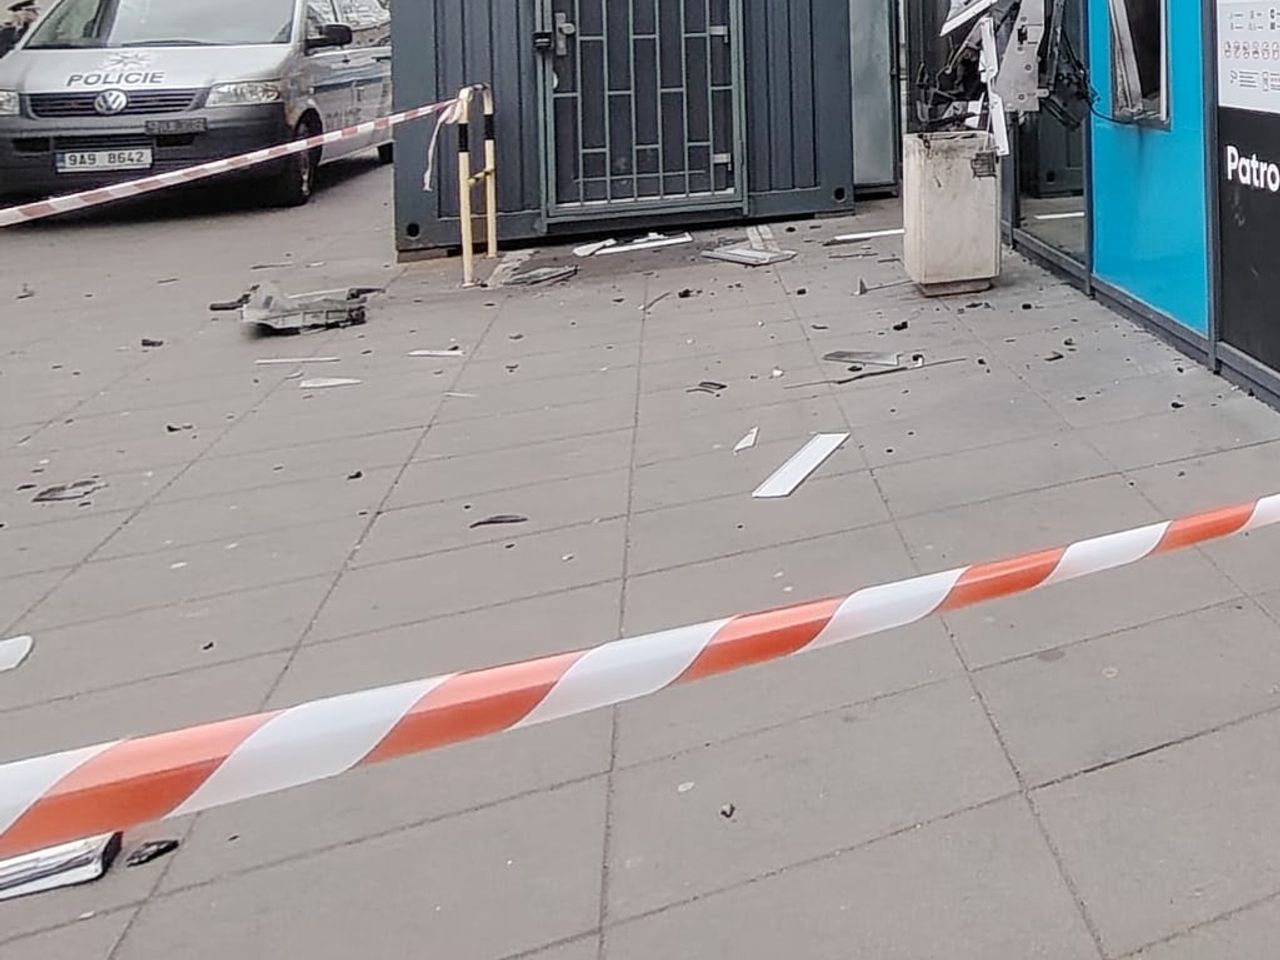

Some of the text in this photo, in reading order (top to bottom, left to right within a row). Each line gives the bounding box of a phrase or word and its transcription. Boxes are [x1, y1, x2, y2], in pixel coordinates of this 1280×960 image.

[66, 72, 165, 87] POLICIE
[68, 151, 144, 166] 9A9 8642
[1227, 144, 1280, 194] Patro
